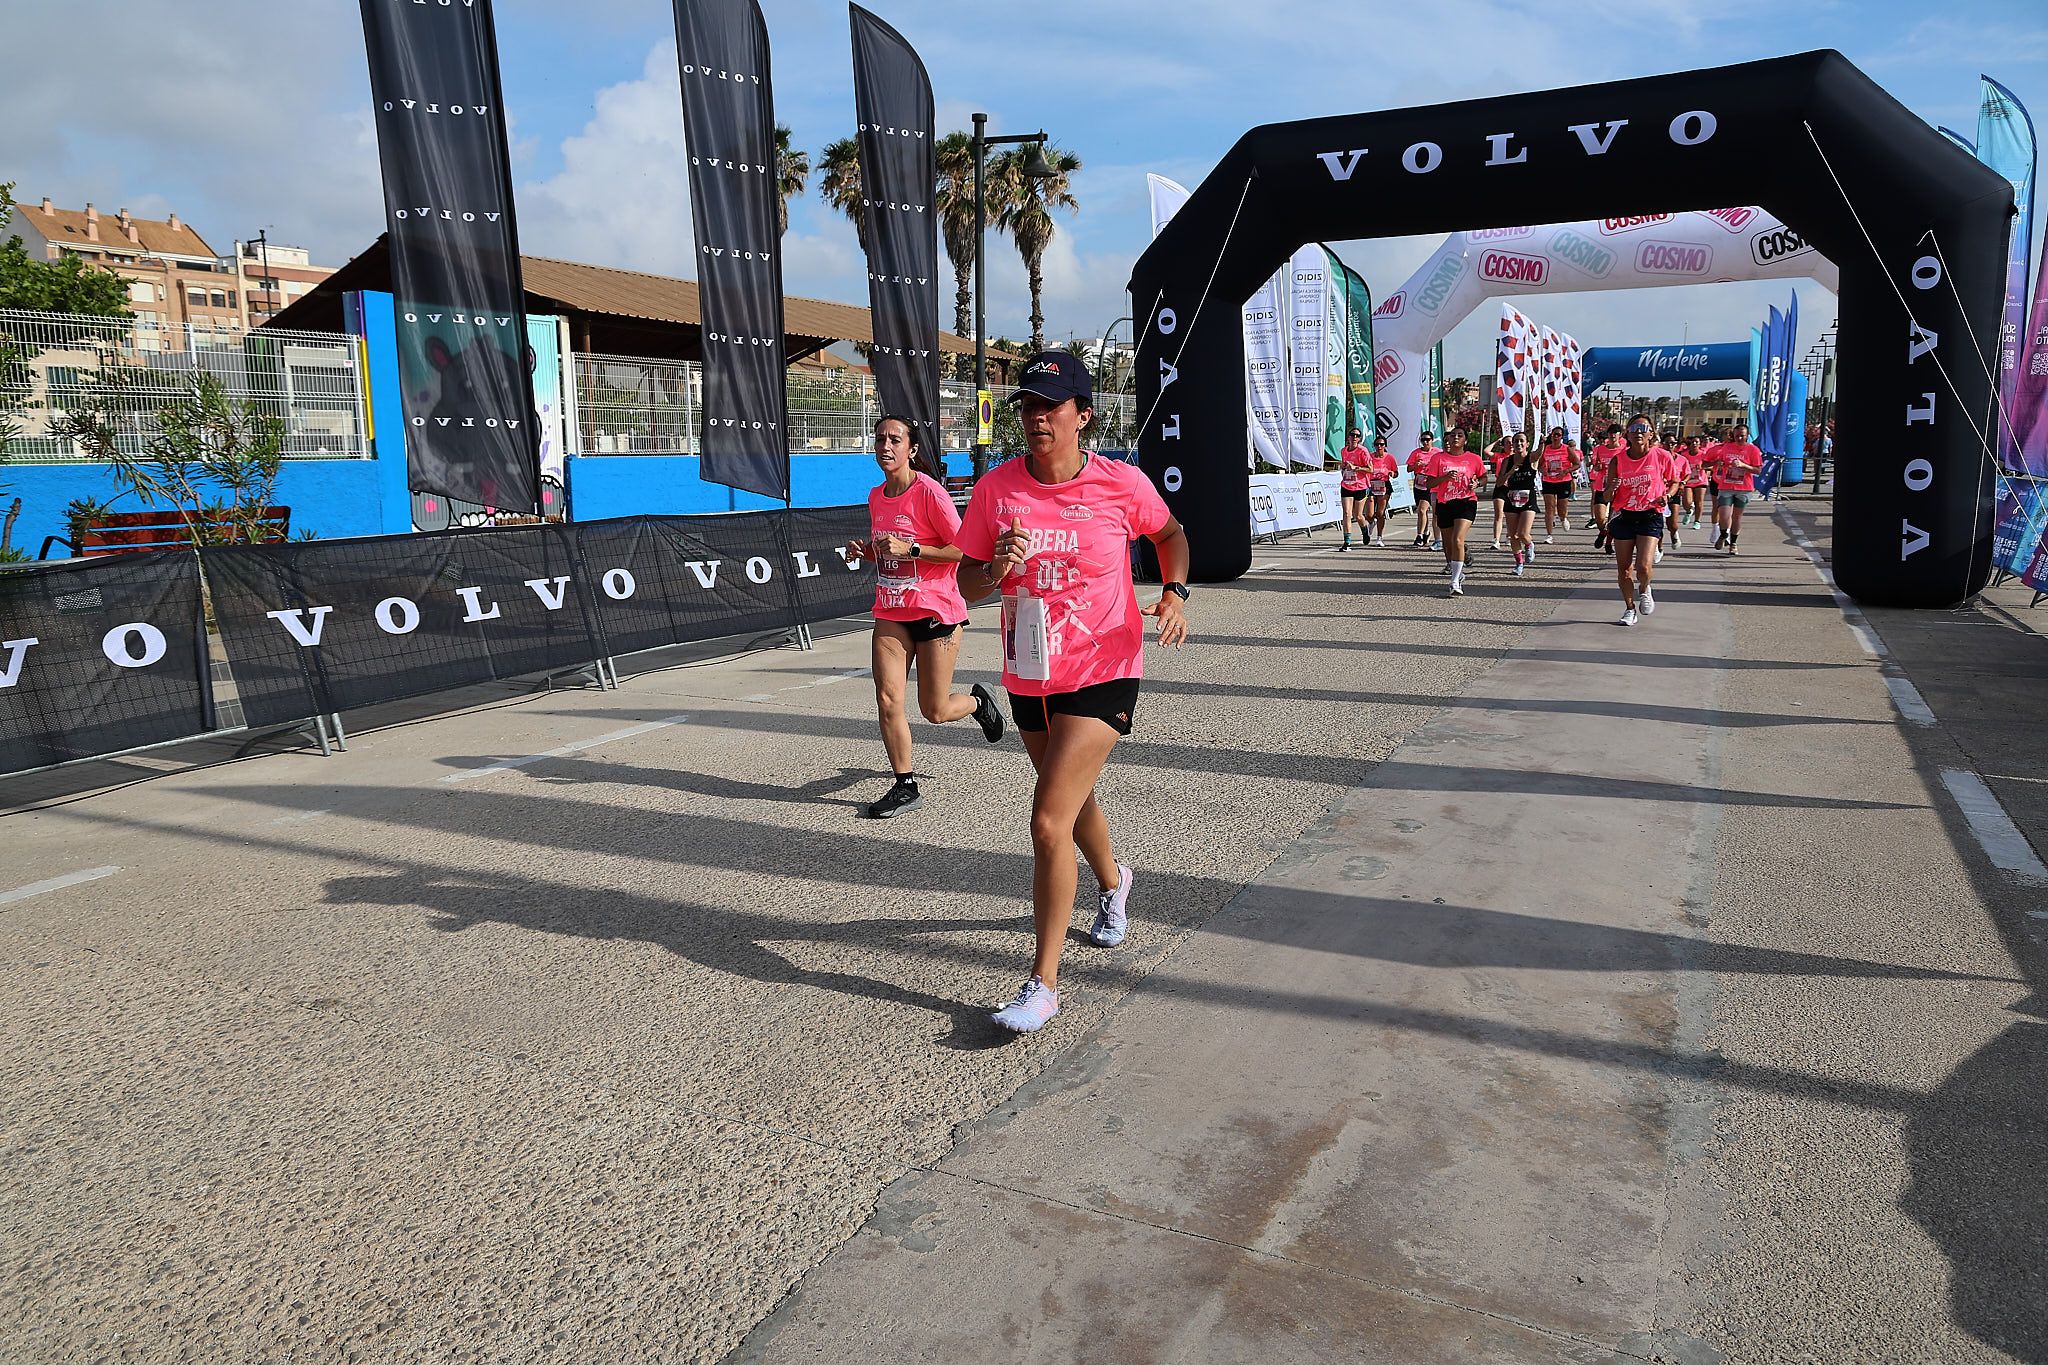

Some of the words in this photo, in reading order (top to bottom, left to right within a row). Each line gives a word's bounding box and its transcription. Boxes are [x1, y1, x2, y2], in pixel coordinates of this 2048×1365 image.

[1317, 111, 1717, 181] VOLVO
[1484, 254, 1543, 282] COSMO
[1553, 232, 1611, 274] COSMO
[1642, 244, 1706, 271] COSMO
[1418, 257, 1463, 311] COSMO
[1157, 308, 1183, 492] OLVO
[1902, 256, 1941, 560] VOLVO
[996, 506, 1031, 514] OYSHO
[685, 547, 861, 588] VOLV
[267, 568, 636, 646] VOLVO
